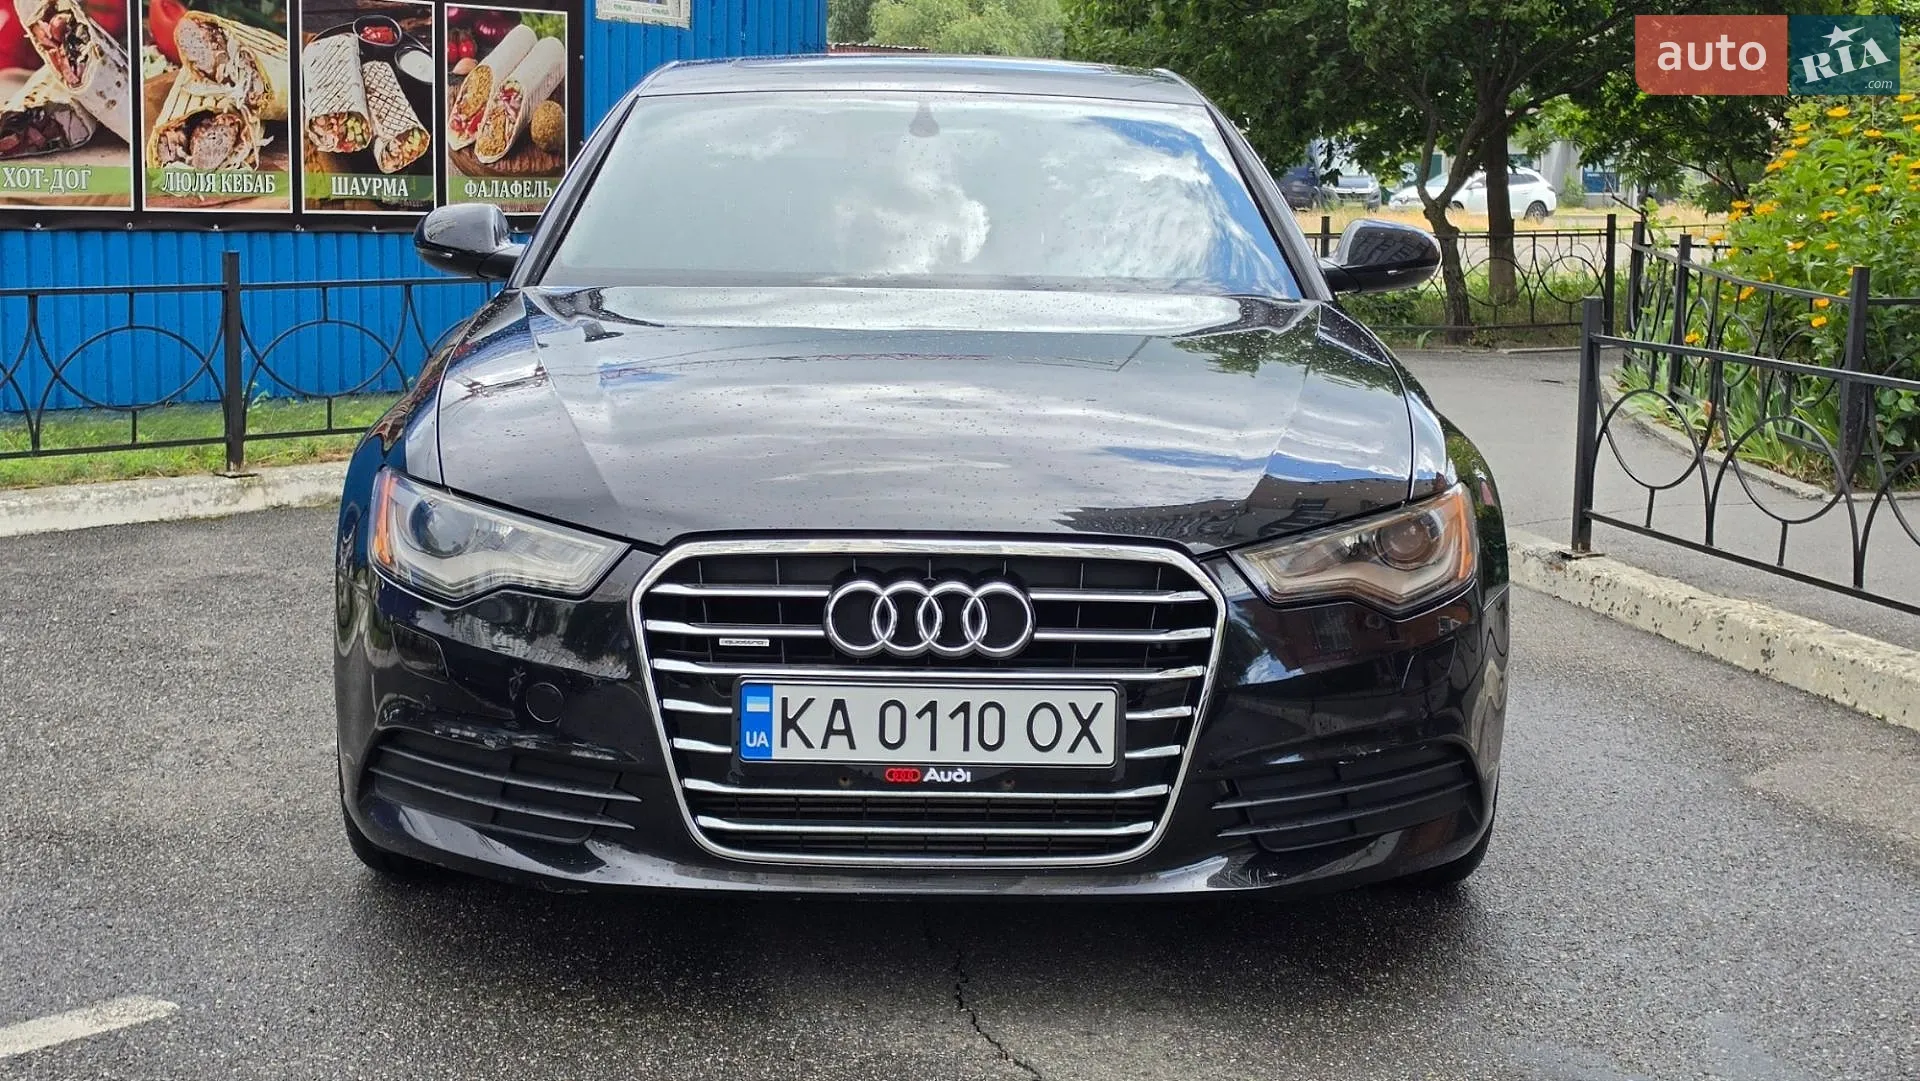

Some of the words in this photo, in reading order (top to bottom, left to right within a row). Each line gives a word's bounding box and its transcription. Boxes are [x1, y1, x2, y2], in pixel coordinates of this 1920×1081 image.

[2, 167, 92, 193] ХОТ-ДОГ
[161, 172, 217, 193] ЛЮЛЯ
[221, 173, 276, 193] КЕБАБ
[331, 176, 409, 197] ШАУРМА
[464, 180, 553, 198] ФАЛАФЕЛЬ
[781, 697, 857, 750] KA
[879, 699, 1006, 752] 0110
[1026, 701, 1104, 754] OX
[745, 731, 769, 748] UA
[922, 767, 972, 783] Audi
